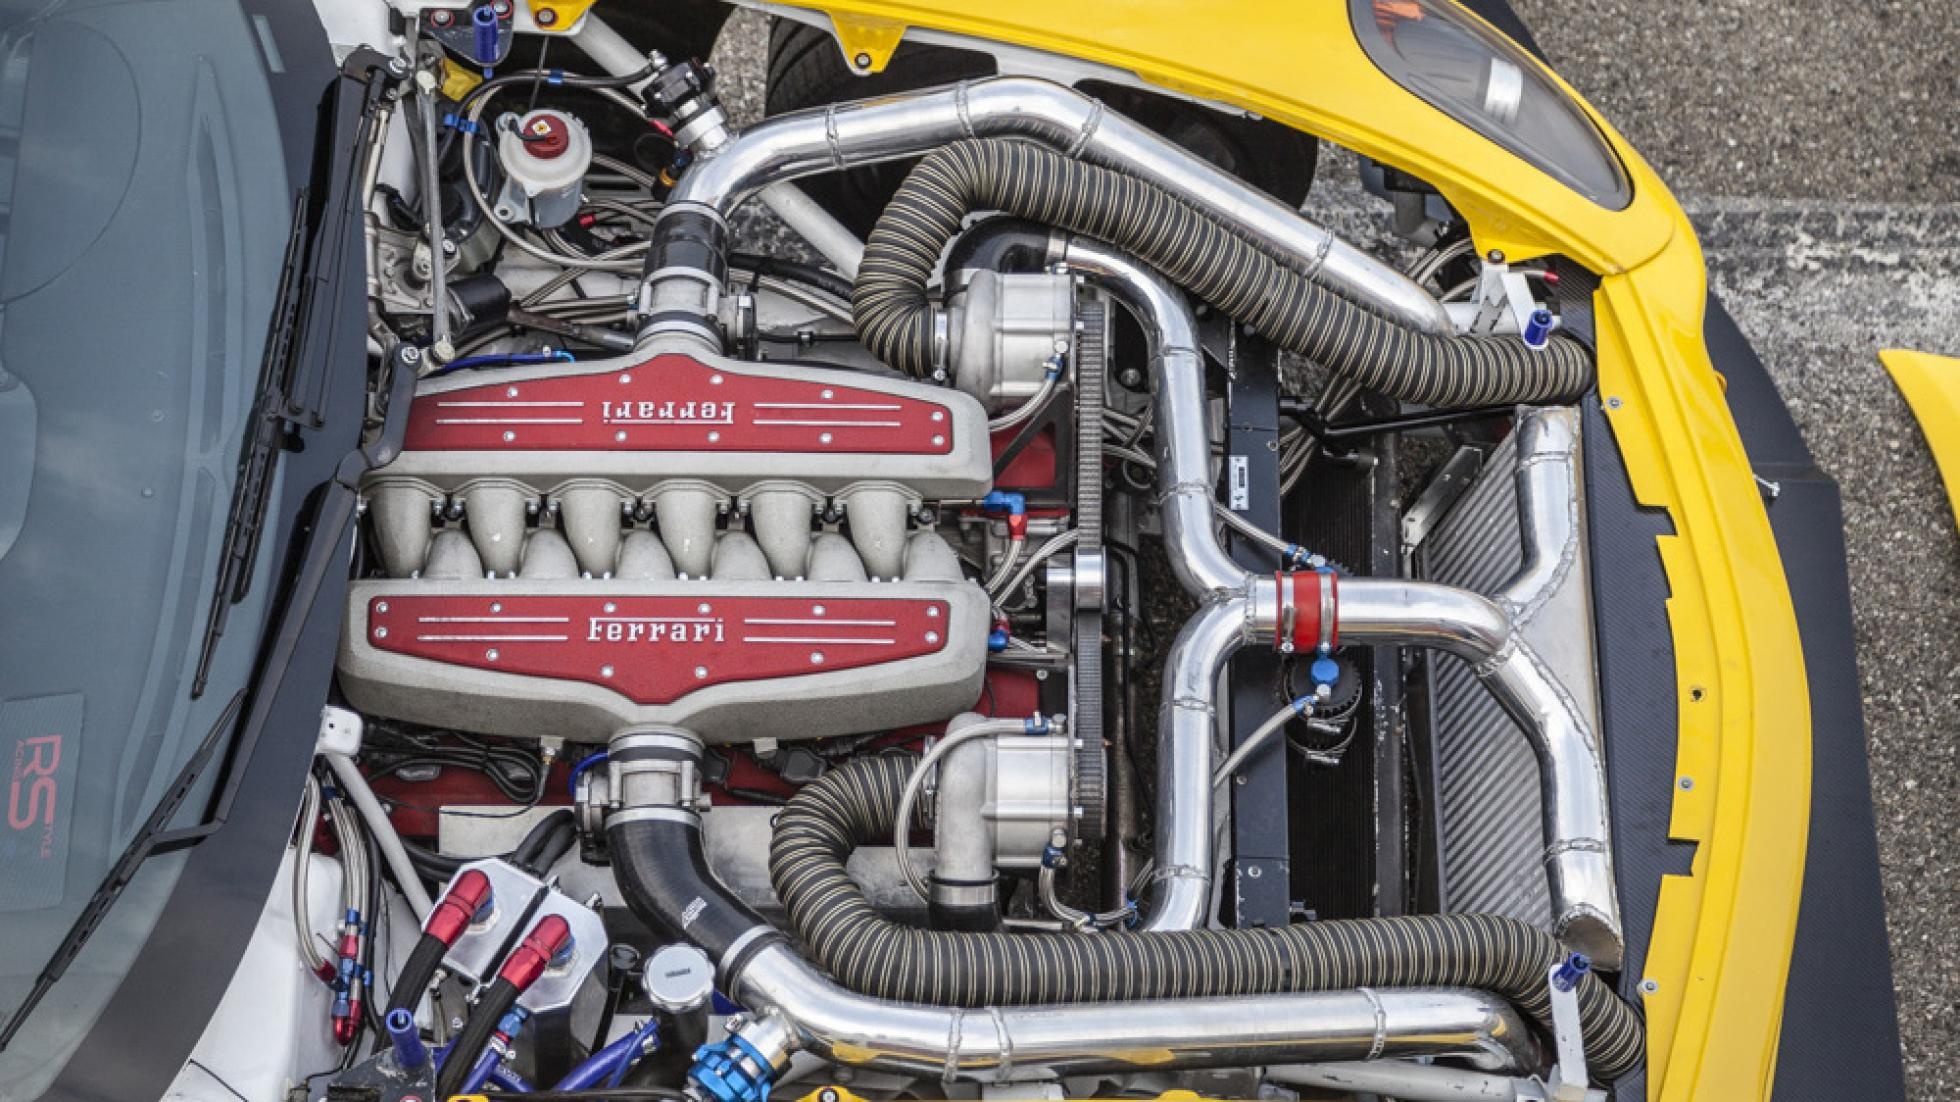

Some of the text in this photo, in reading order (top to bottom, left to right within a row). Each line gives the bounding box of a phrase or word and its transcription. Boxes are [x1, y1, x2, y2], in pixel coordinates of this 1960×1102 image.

[602, 401, 735, 424] Ferrari
[587, 617, 725, 642] Ferrari
[8, 735, 62, 829] RS
